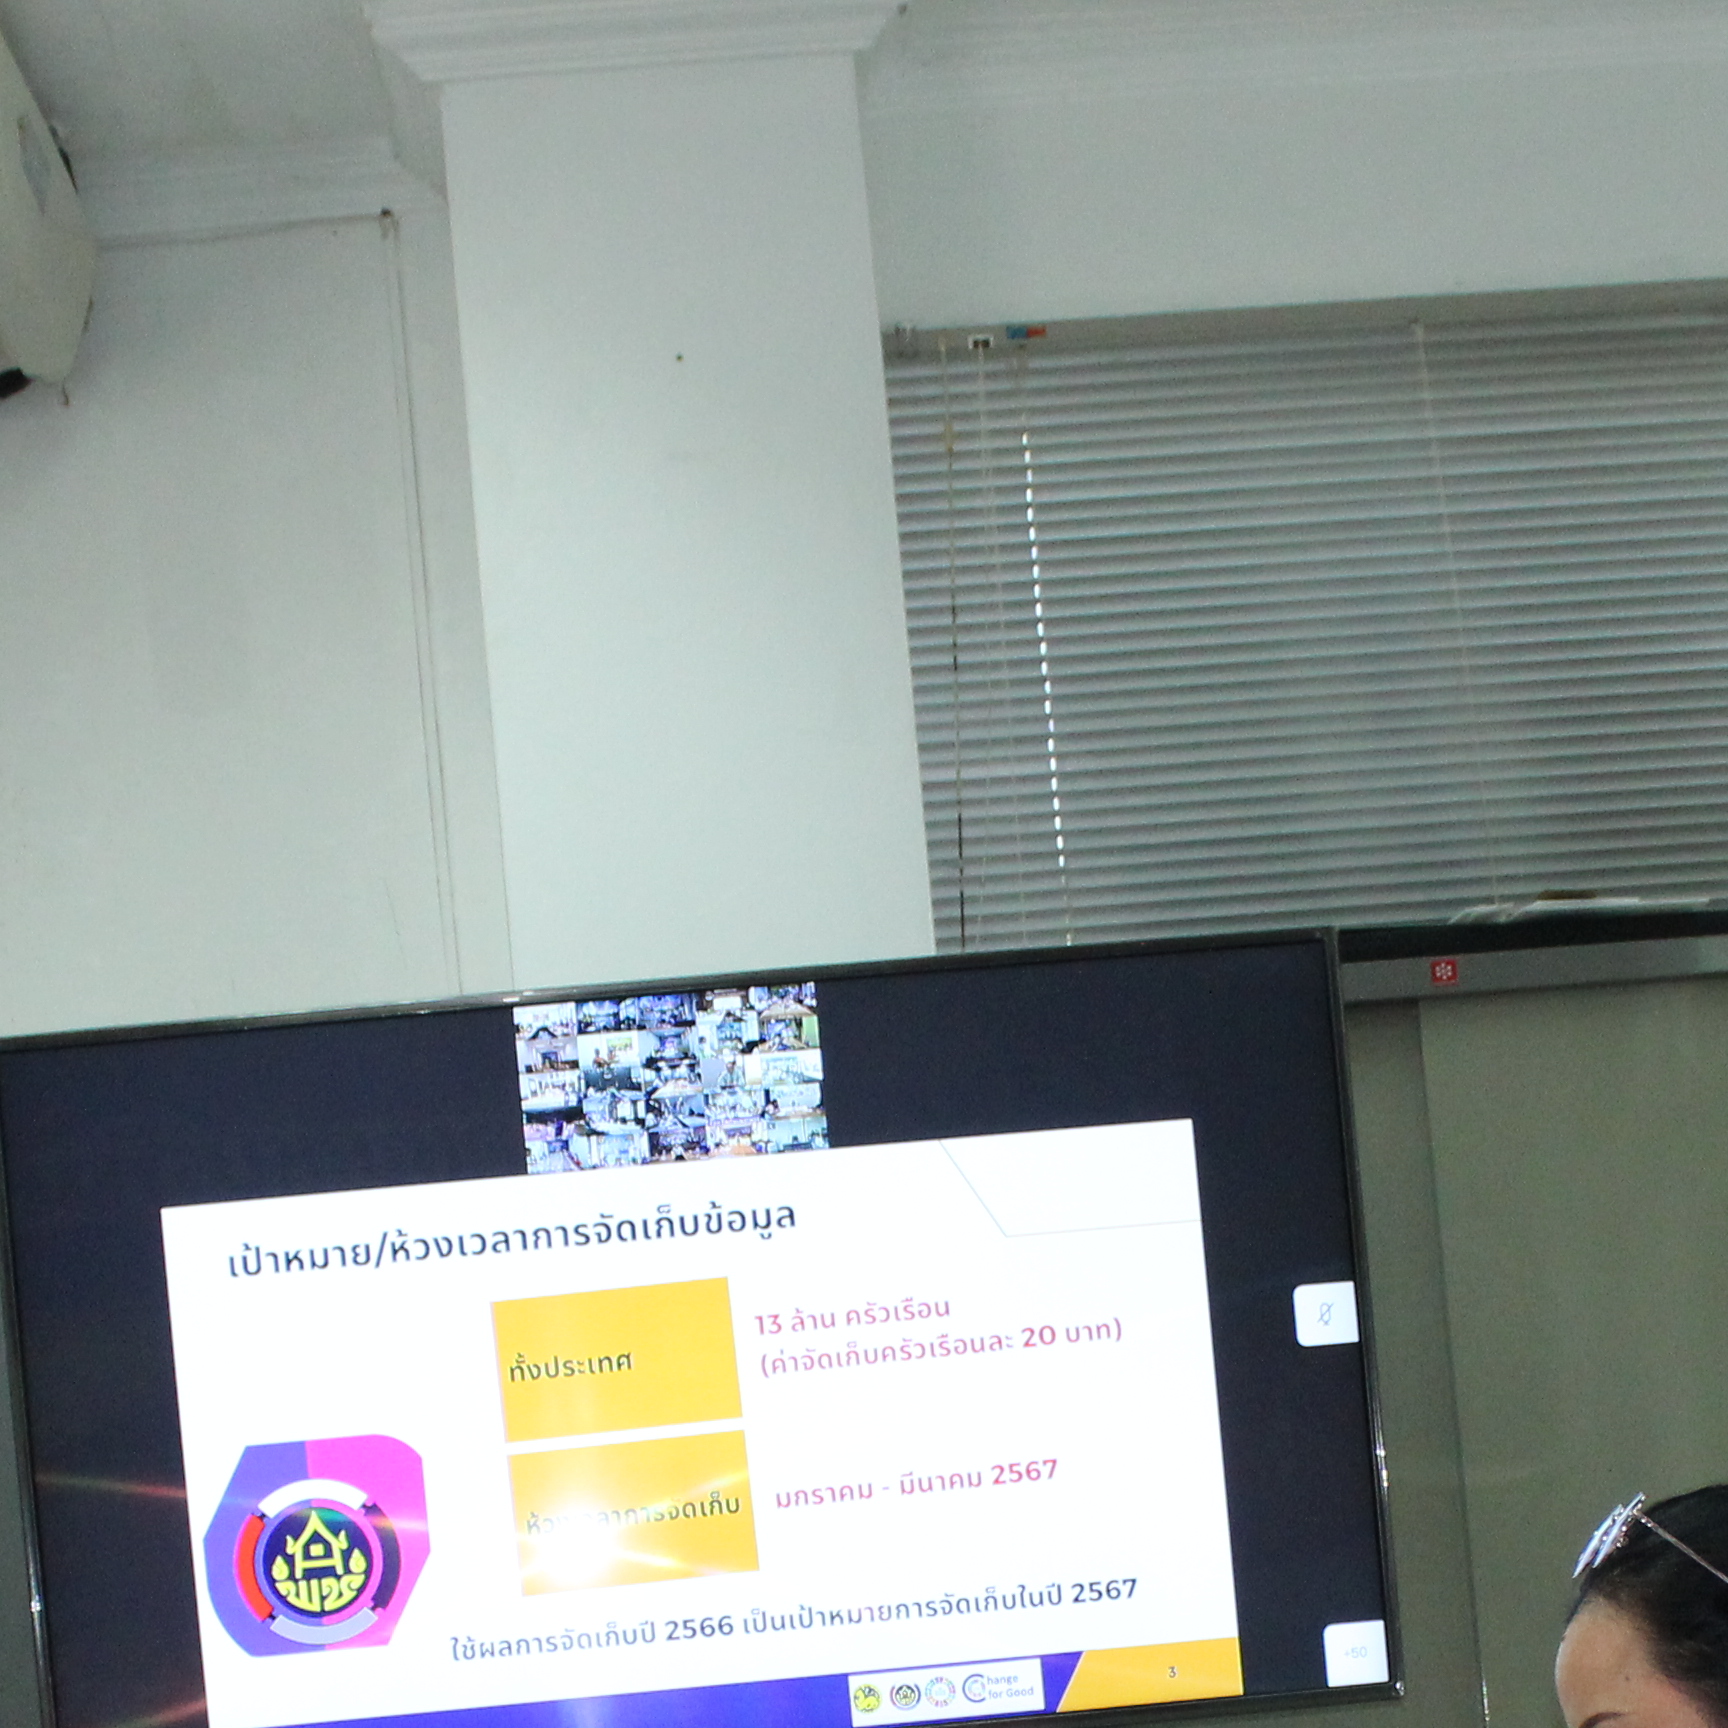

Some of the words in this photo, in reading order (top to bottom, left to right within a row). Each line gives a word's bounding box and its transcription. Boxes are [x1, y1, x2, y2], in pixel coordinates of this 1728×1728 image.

[228, 1200, 797, 1278] เป้าหมาย/ห้วงเวลาการจัดเก็บข้อมูล
[755, 1313, 783, 1335] 13
[790, 1307, 837, 1333] ล้าน
[845, 1296, 951, 1328] ครัวเรือน
[509, 1350, 634, 1383] ทั้งประเทศ
[760, 1332, 1015, 1379] (ค่าจัดเก็บครัวเรือนละ
[1021, 1324, 1057, 1348] 20
[1065, 1317, 1123, 1344] บาท)
[775, 1482, 874, 1510] มกราคม
[899, 1471, 983, 1496] มีนาคม
[991, 1458, 1059, 1486] 2567
[451, 1619, 657, 1662] ใช้ผลการจัดเก็บปี
[664, 1614, 734, 1642] 2566
[742, 1583, 1063, 1635] เป็นเป้าหมายการจัดเก็บในปี
[1071, 1577, 1138, 1604] 2567
[1343, 1645, 1368, 1659] +50
[988, 1688, 1004, 1699] for
[1006, 1685, 1034, 1699] Good
[1168, 1666, 1177, 1679] 3
